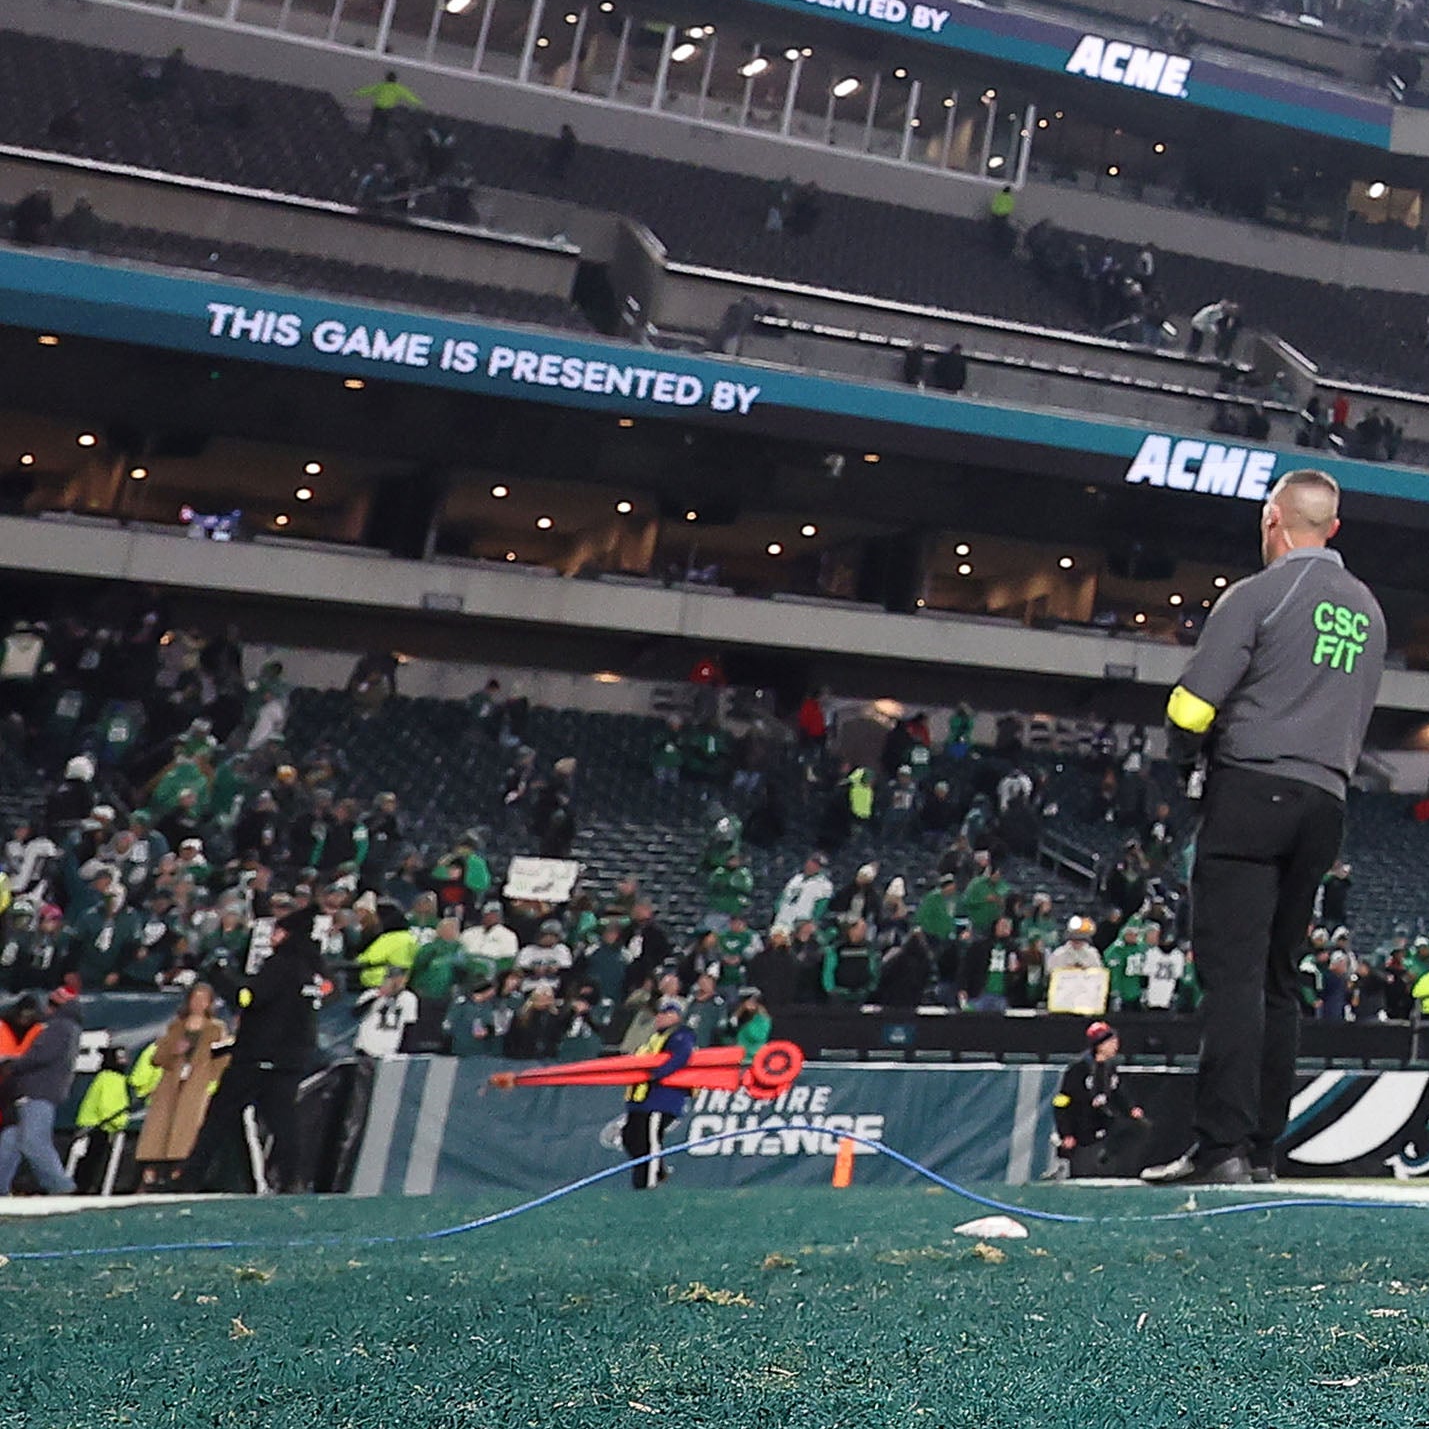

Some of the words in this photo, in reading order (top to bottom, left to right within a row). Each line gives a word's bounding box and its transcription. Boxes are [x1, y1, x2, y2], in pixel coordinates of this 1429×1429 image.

[911, 3, 950, 34] BY
[206, 301, 302, 348] THIS
[310, 319, 434, 367] GAME
[439, 338, 479, 374] IS
[487, 345, 704, 407] PRESENTED
[711, 380, 761, 416] BY
[1313, 601, 1370, 643] CSC
[1311, 634, 1364, 674] FIT
